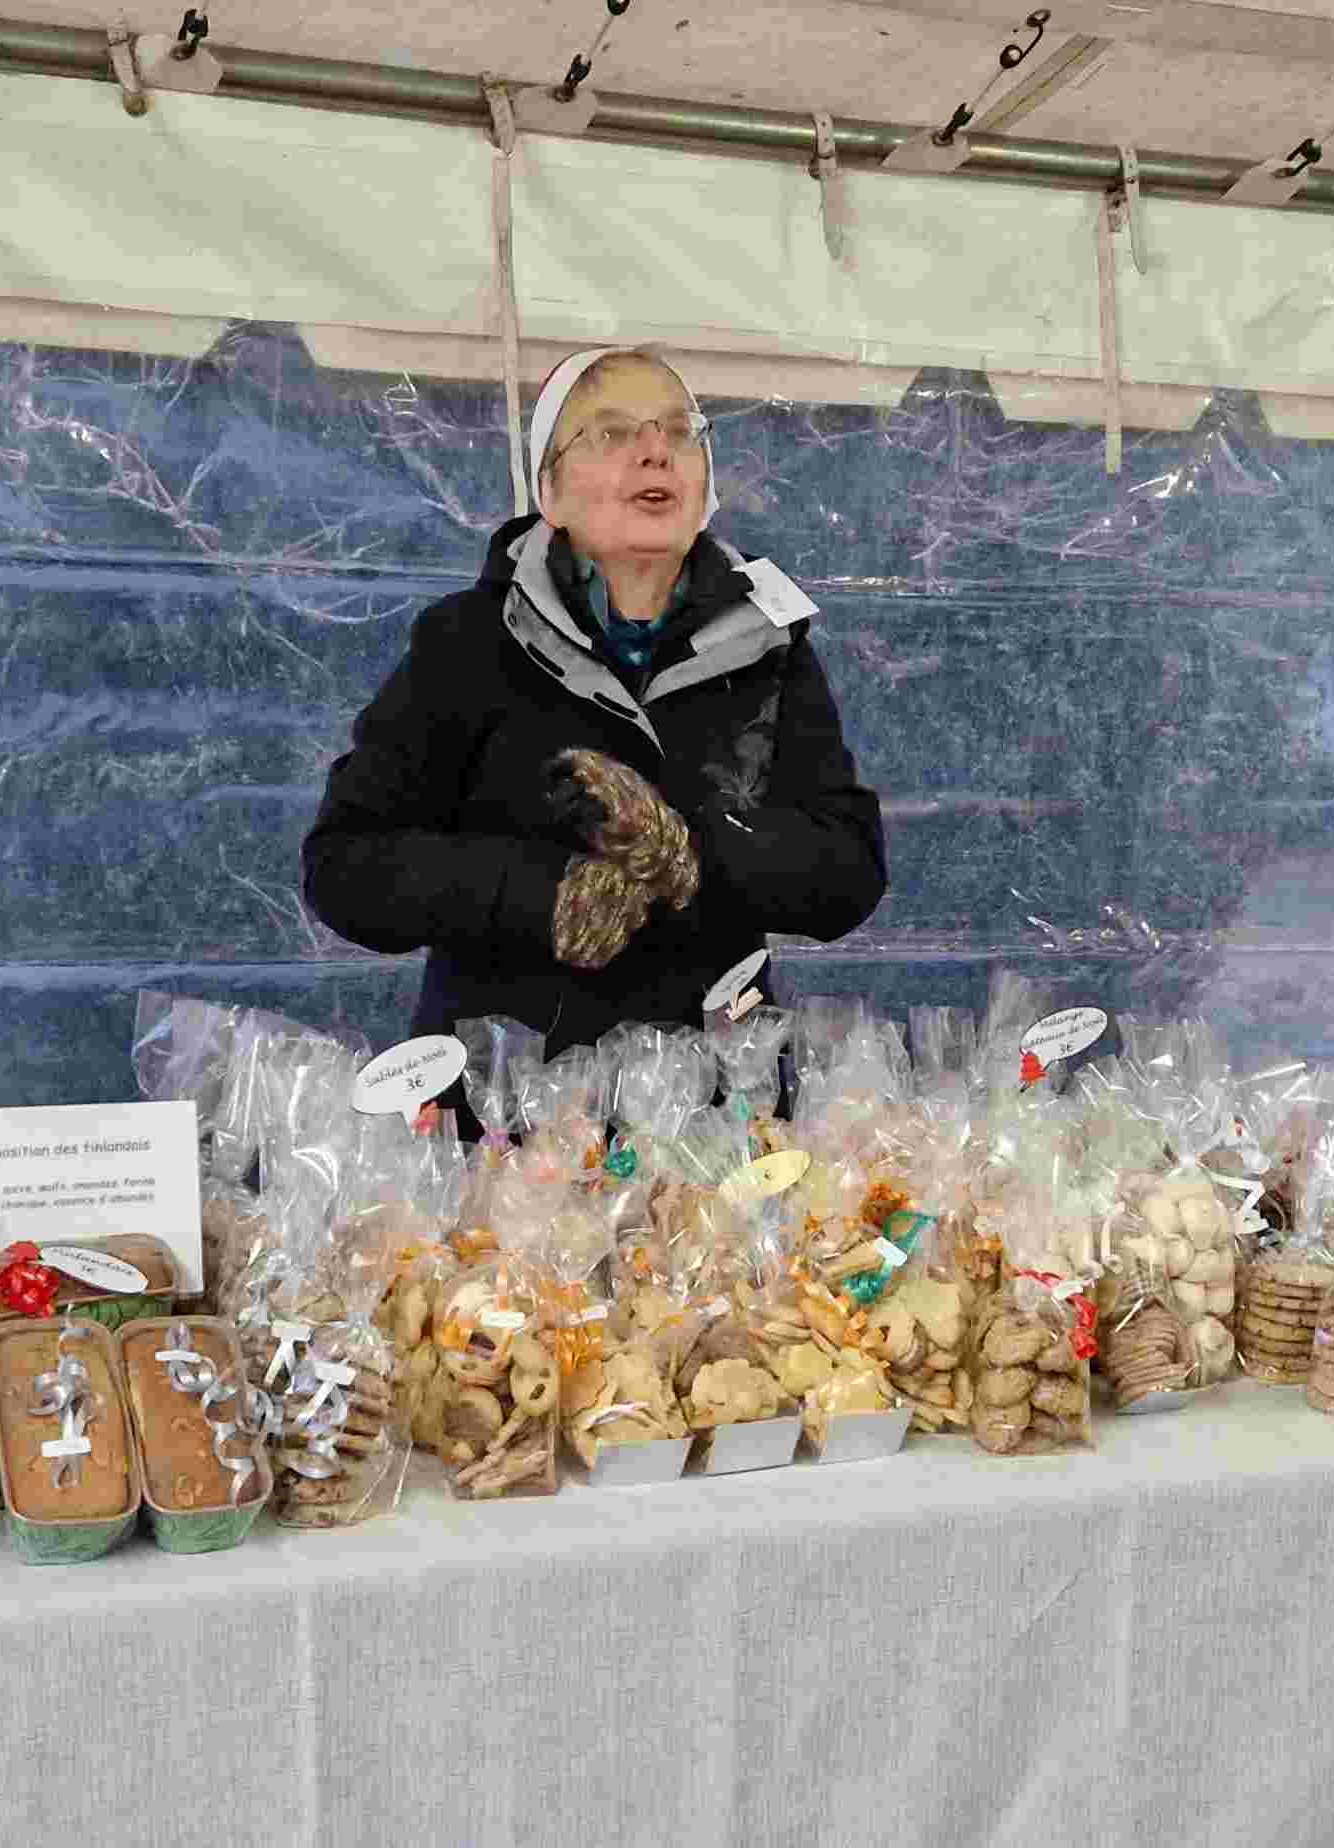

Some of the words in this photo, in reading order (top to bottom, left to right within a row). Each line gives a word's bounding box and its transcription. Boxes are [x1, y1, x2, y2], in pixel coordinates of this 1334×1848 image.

[405, 1072, 426, 1090] 3€
[53, 1142, 80, 1156] des
[83, 1137, 152, 1154] finlandais
